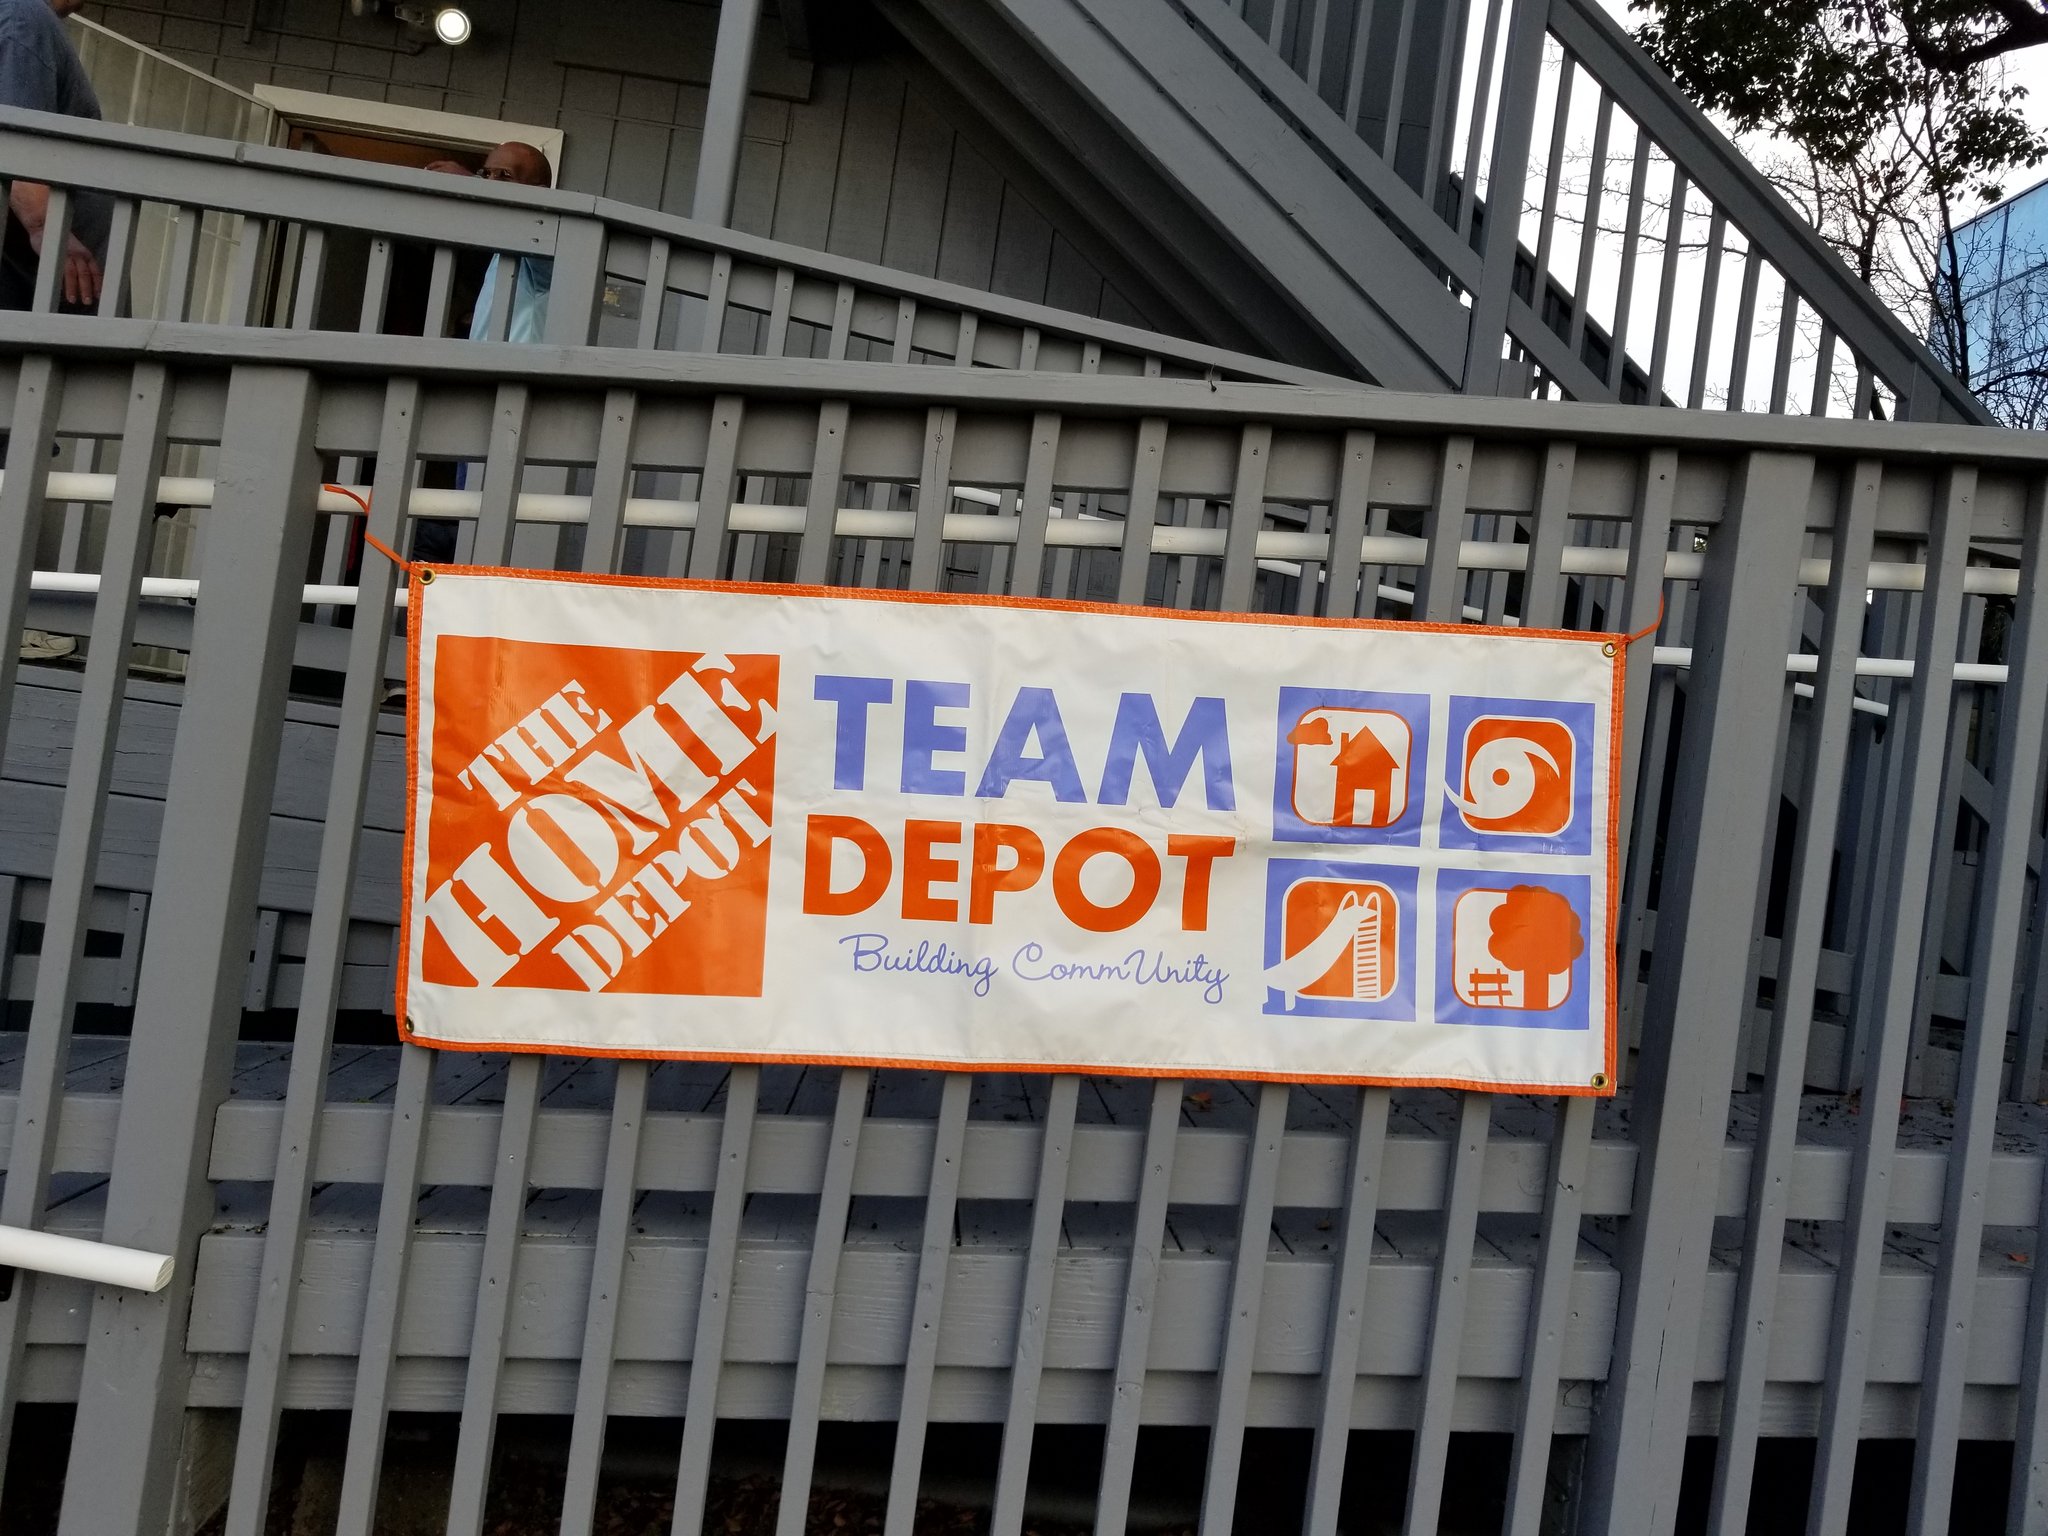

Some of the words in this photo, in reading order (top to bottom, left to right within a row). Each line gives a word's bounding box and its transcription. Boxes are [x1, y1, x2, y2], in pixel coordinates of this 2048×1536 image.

[457, 679, 613, 811] THE
[814, 675, 1236, 811] TEAM
[425, 653, 777, 987] HOME
[552, 778, 772, 992] DEPOT
[803, 814, 1236, 932] DEPOT
[839, 933, 998, 997] Building
[1012, 942, 1229, 1004] CommUnity
